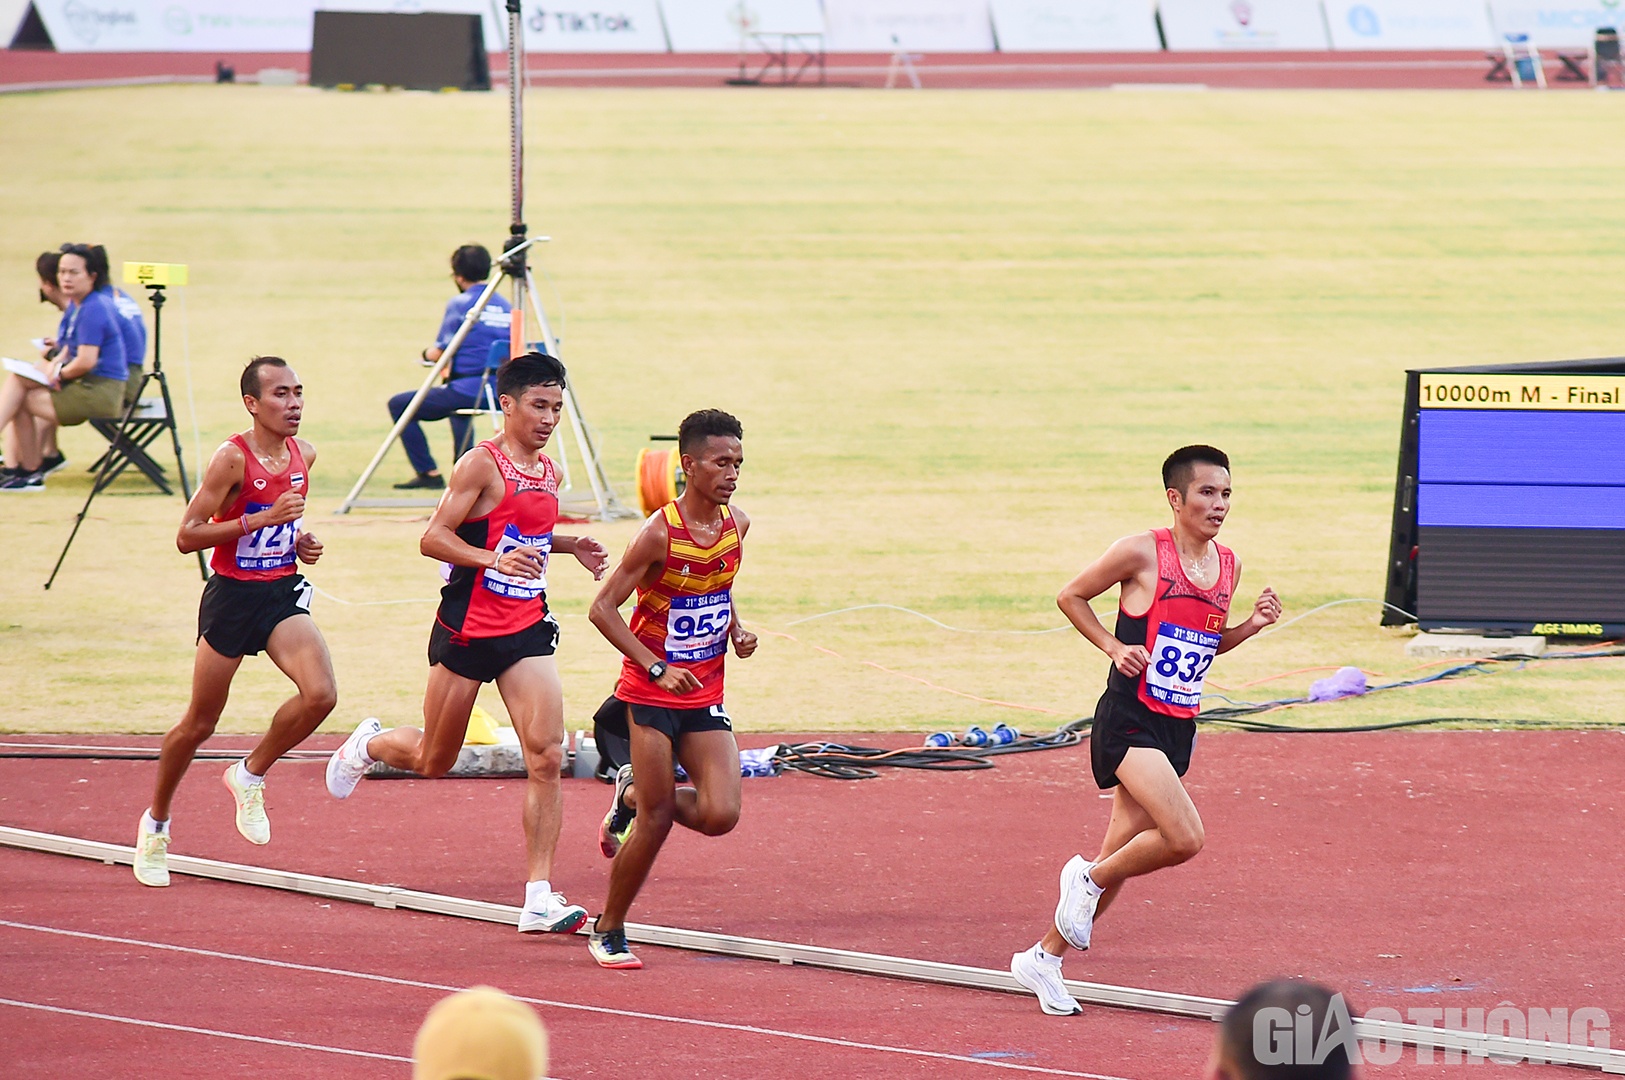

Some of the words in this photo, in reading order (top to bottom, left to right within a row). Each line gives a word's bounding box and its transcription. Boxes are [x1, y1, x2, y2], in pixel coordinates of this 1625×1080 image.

[554, 11, 636, 31] TikTok
[1423, 384, 1511, 403] 10000m
[1521, 386, 1541, 403] M
[1567, 386, 1620, 405] Final
[673, 609, 730, 642] 952
[1185, 629, 1199, 643] SEA
[1155, 645, 1215, 683] 832
